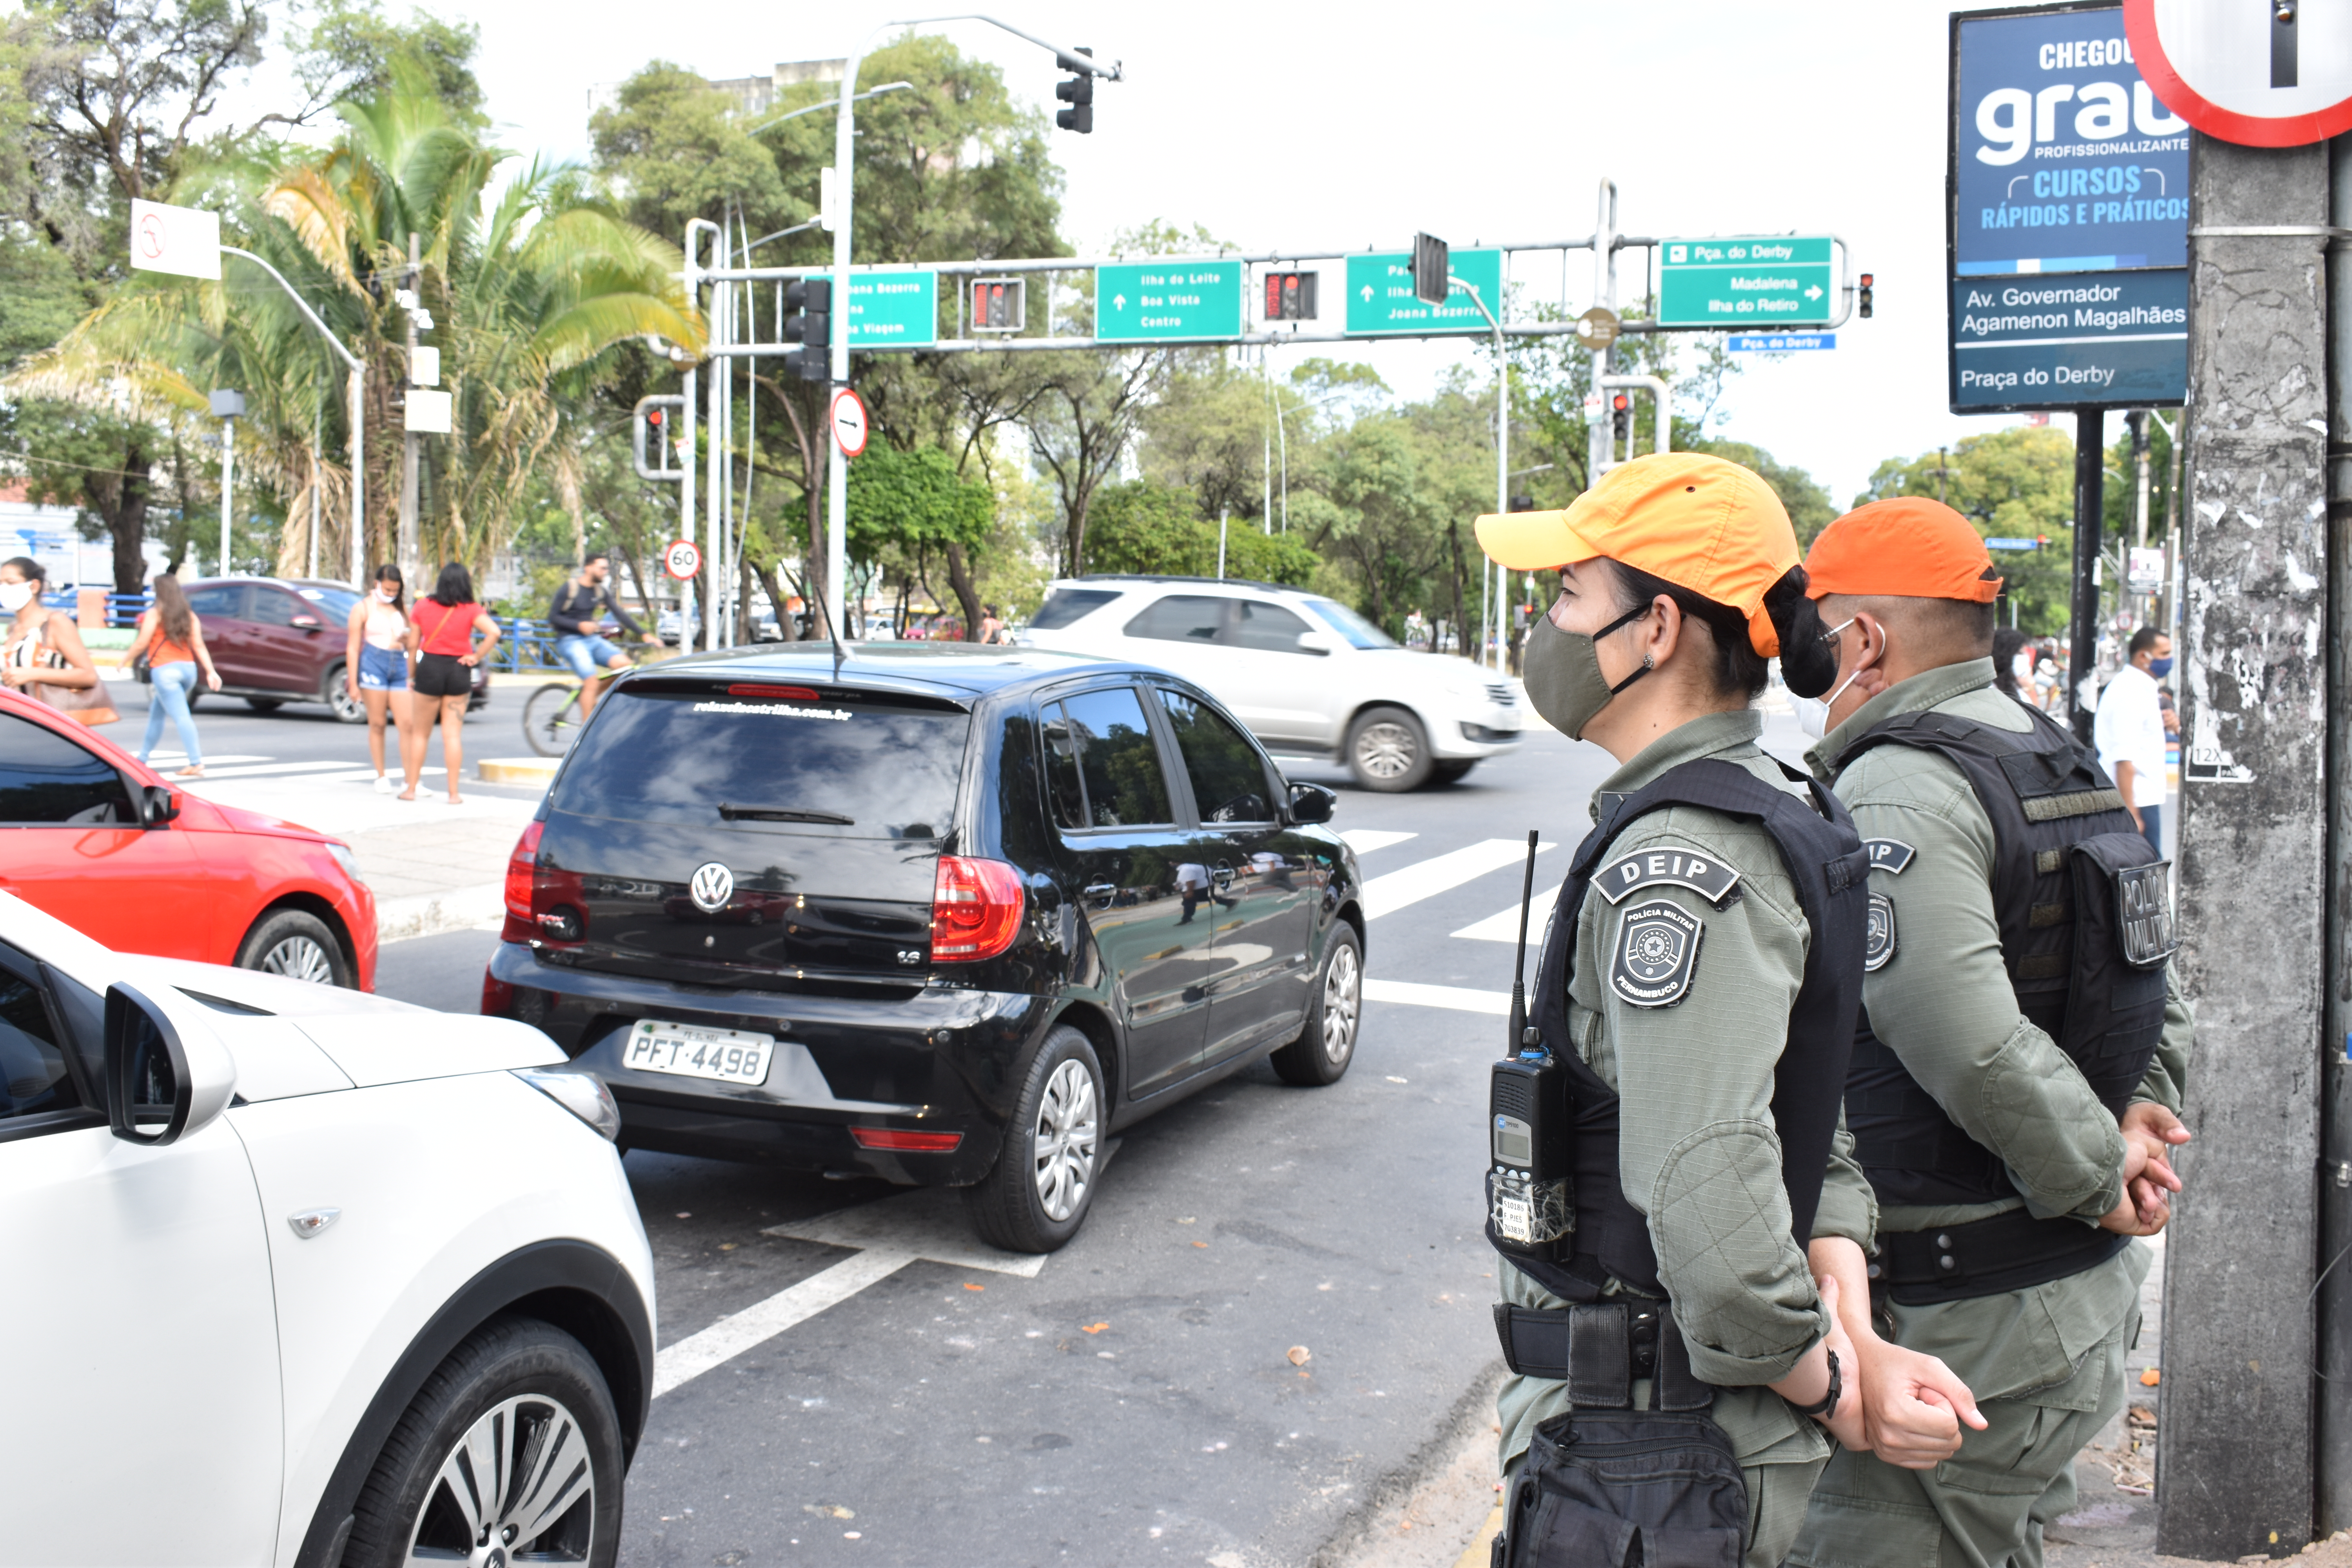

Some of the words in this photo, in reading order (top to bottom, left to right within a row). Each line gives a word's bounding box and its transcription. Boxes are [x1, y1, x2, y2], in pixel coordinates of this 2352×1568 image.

[1976, 81, 2189, 166] grau
[2035, 139, 2189, 159] PROFISSIONALIZANTE
[2033, 165, 2141, 198] CURSOS
[1982, 201, 2069, 229] RÁPIDOS
[2076, 202, 2087, 224] E
[1695, 247, 1724, 261] Pça.
[1728, 246, 1746, 259] do
[1752, 245, 1792, 260] Derby
[1142, 275, 1164, 285] Ilha
[1170, 275, 1184, 285] do
[1190, 273, 1220, 283] Leite
[1731, 277, 1798, 290] Madalena
[849, 285, 873, 294] oana
[877, 283, 920, 294] Bezerra
[1388, 287, 1412, 297] Ilha
[1141, 296, 1163, 306] Boa
[1169, 295, 1200, 305] Vista
[1966, 290, 1995, 307] Av.
[2002, 285, 2120, 306] Governador
[1709, 300, 1733, 312] Ilha
[1736, 299, 1753, 312] do
[1758, 298, 1798, 312] Retiro
[1388, 309, 1426, 319] Joana
[1432, 307, 1482, 318] Bezerra
[1962, 310, 2068, 333] Agamenon
[2075, 305, 2185, 329] Magalhães
[864, 323, 904, 335] Viagem
[1141, 317, 1181, 327] Centro
[1742, 339, 1767, 350] Pça.
[1769, 338, 1784, 348] do
[1786, 337, 1821, 349] Derby
[1961, 369, 2018, 391] Praça
[2024, 368, 2049, 385] do
[2056, 365, 2114, 386] Derby
[672, 551, 694, 565] 60
[1869, 845, 1891, 860] IP
[1621, 855, 1707, 884] DEIP
[1628, 909, 1661, 922] POLÍCIA
[1663, 910, 1695, 931] MILITAR
[2127, 914, 2170, 955] MILIT
[1617, 975, 1678, 998] PERNAMBUCO
[1504, 1201, 1524, 1212] 510186
[1504, 1224, 1524, 1235] 703839
